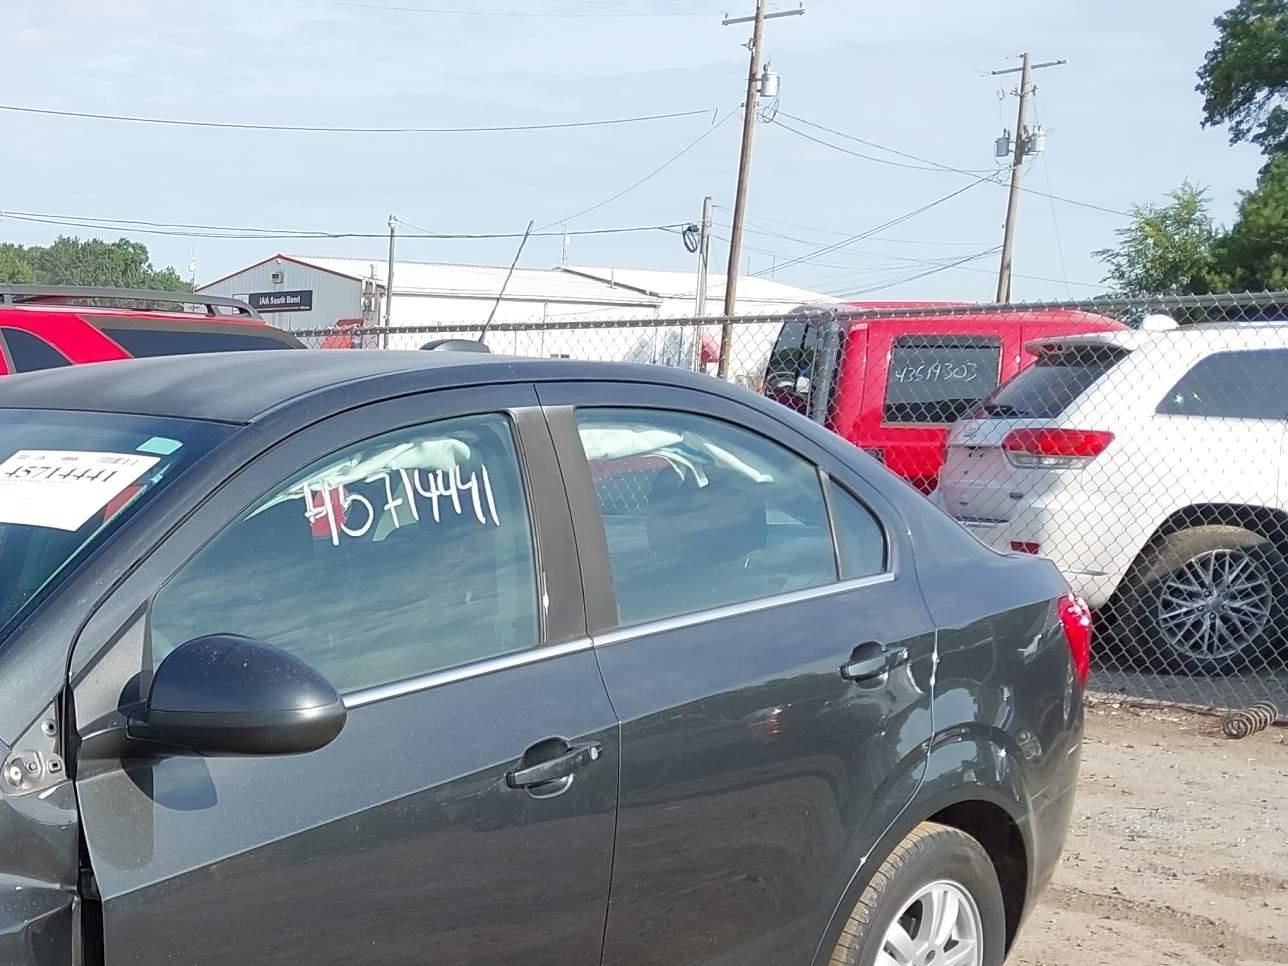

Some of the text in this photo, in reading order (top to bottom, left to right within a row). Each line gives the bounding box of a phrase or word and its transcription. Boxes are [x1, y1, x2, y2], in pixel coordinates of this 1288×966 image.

[259, 295, 300, 305] IAA South Bend
[895, 362, 977, 383] 43519303
[5, 466, 117, 482] 45714441
[304, 464, 500, 546] 45714441
